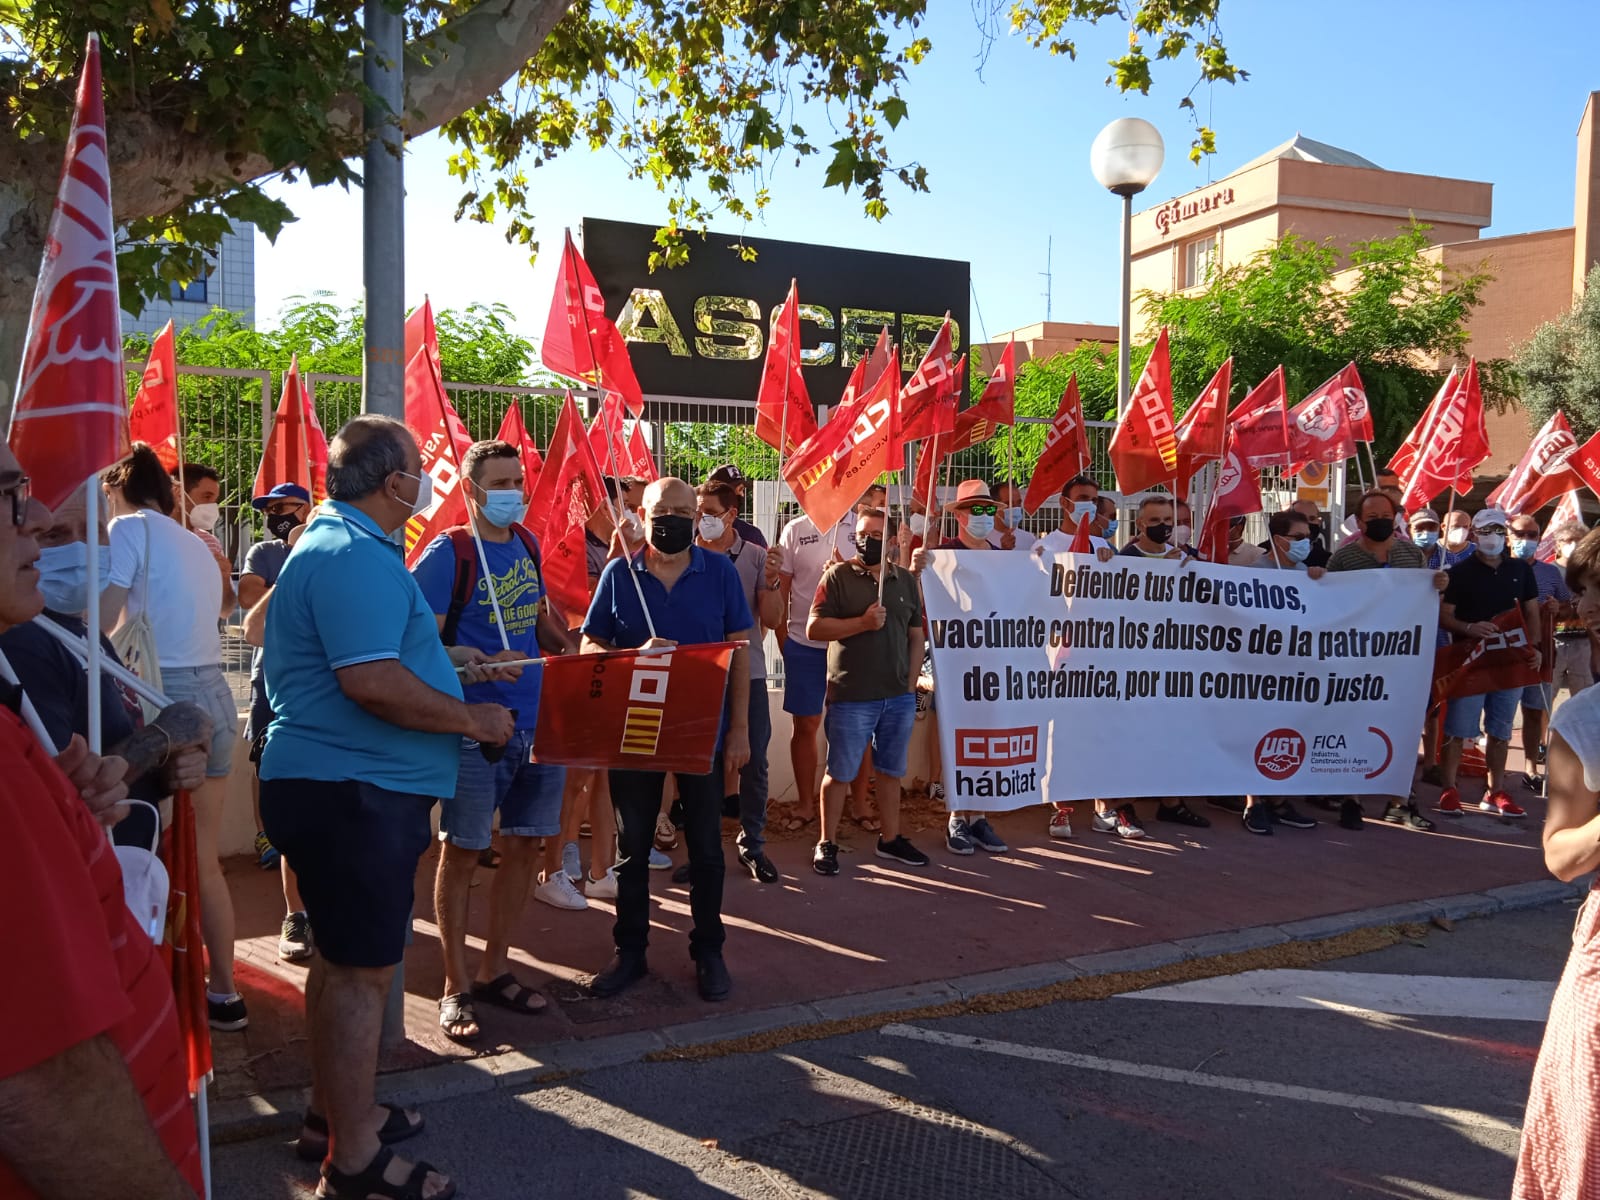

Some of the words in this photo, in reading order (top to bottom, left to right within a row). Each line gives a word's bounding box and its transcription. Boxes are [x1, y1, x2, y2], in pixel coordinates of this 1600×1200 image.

[1049, 562, 1140, 601] Defiende
[1144, 571, 1174, 603] tus
[1178, 572, 1307, 614] derechos,
[931, 611, 1046, 650] vacúnate
[1049, 616, 1115, 650] contra
[1118, 616, 1149, 650] los
[1152, 618, 1242, 653] abusos
[1248, 623, 1283, 656] de
[1288, 625, 1312, 657] la
[1318, 624, 1423, 661] patronal
[963, 665, 1000, 702] de
[1005, 665, 1023, 701] la
[1027, 663, 1121, 701] cerámica,
[1125, 669, 1161, 701] por
[1165, 670, 1194, 698] un
[1199, 671, 1320, 703] convenio
[1324, 672, 1389, 706] justo.
[963, 734, 1034, 759] CCOO
[1260, 736, 1301, 756] UGT
[1312, 734, 1348, 750] FICA
[956, 768, 1036, 797] hábitat
